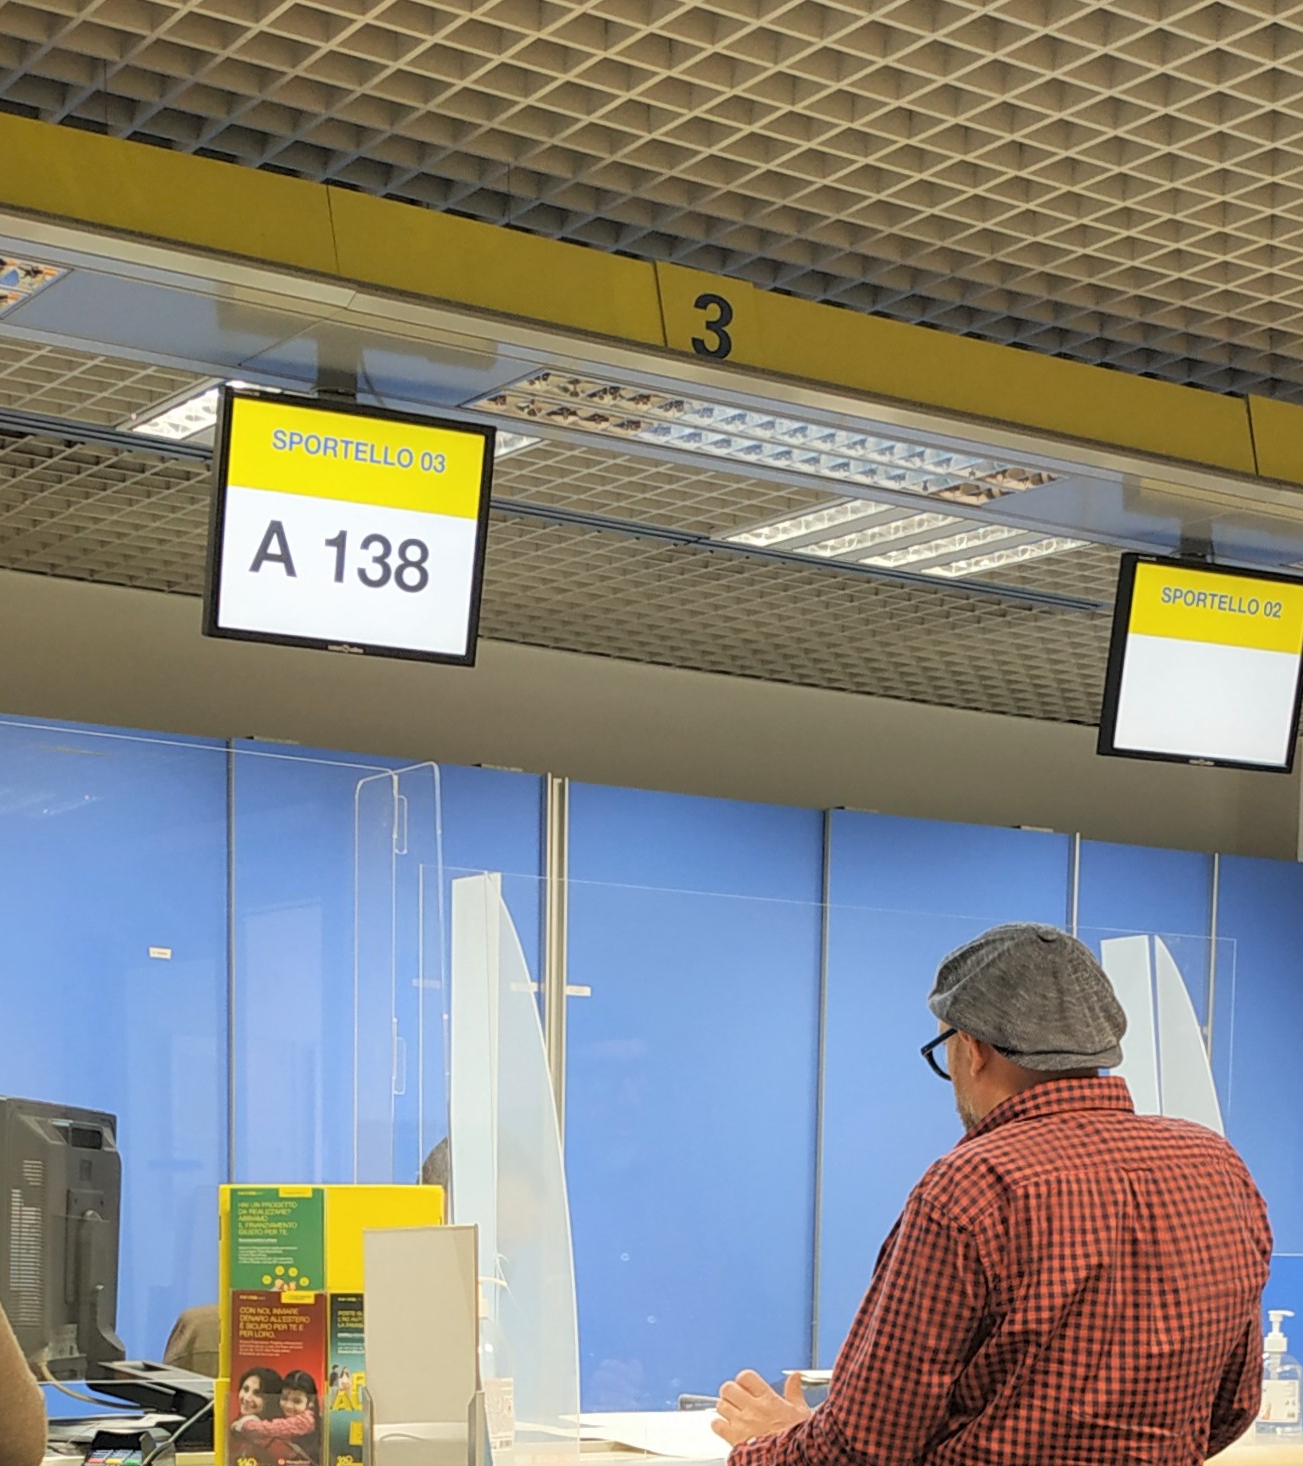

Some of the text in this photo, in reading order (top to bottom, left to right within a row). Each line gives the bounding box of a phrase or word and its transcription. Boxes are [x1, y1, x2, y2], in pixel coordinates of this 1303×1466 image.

[691, 293, 733, 359] 3
[272, 429, 446, 473] SPORTELLO 03
[248, 519, 429, 593] A 138
[1161, 586, 1283, 618] SPORTELLO 02
